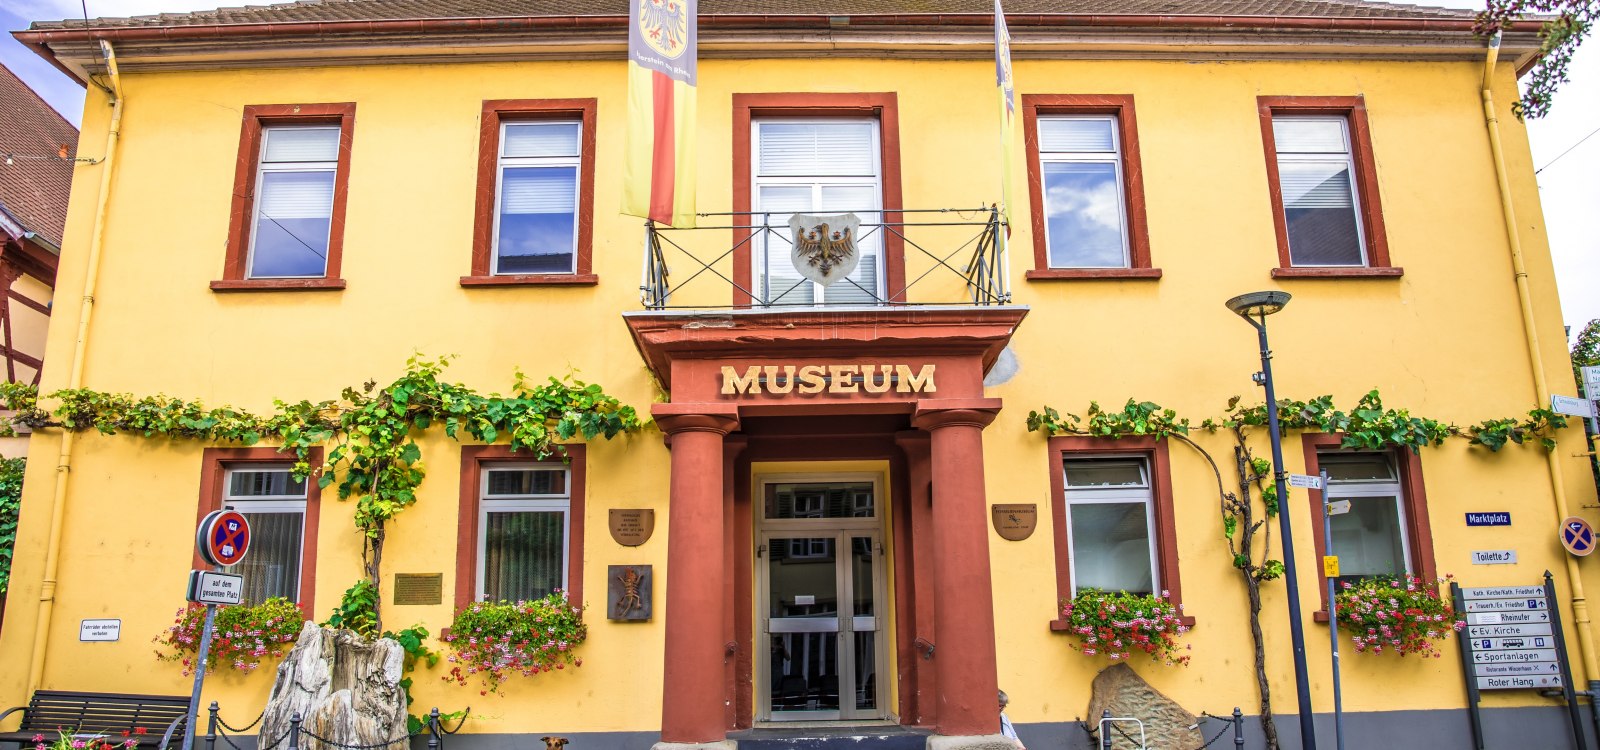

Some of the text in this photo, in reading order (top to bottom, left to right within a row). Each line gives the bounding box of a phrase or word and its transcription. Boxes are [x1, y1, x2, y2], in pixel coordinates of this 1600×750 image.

[721, 364, 937, 395] MUSEUM
[1469, 514, 1508, 525] Marktplatz
[1476, 552, 1502, 561] Toilette
[212, 580, 232, 588] auf dem
[202, 590, 238, 599] gesamten Platz
[1501, 613, 1531, 621] Rheinufer
[1484, 652, 1539, 662] Sportanlagen
[1488, 677, 1534, 687] Roter Hang
